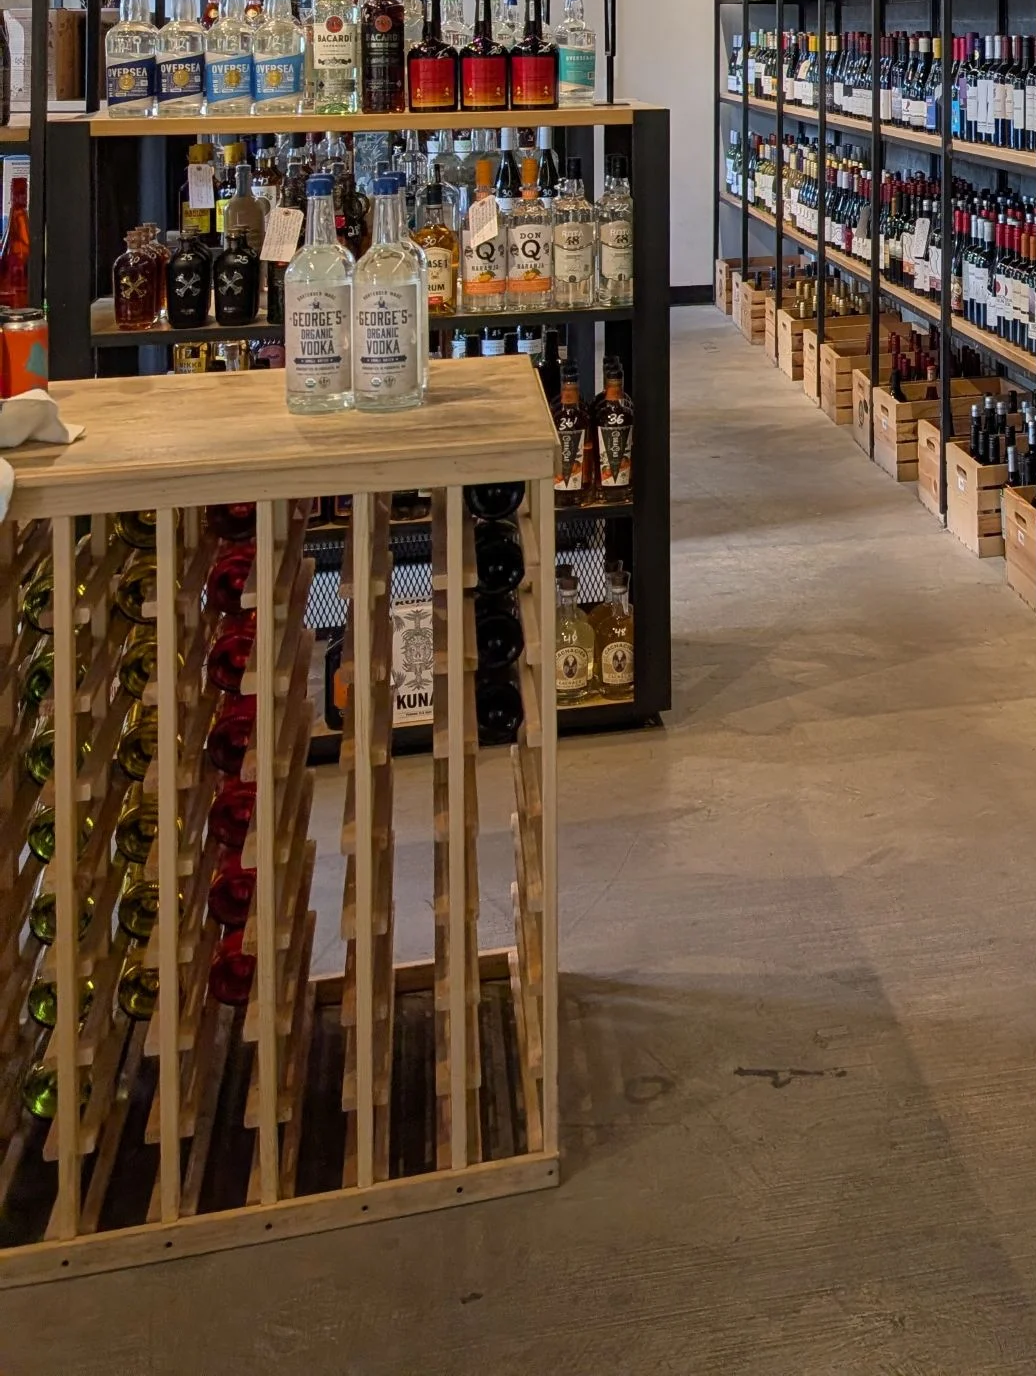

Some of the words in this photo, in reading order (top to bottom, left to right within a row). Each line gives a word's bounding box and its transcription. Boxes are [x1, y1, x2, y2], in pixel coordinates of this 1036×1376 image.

[520, 231, 541, 239] DON
[180, 253, 193, 261] 25
[476, 242, 496, 263] Q
[521, 239, 541, 261] Q
[293, 310, 342, 327] GEORGE'S
[359, 309, 408, 326] GEORGE'S
[301, 327, 333, 340] ORGANIC
[366, 327, 399, 339] ORGANIC
[300, 340, 335, 355] VODKA
[366, 339, 400, 355] VODKA
[609, 413, 624, 425] 36
